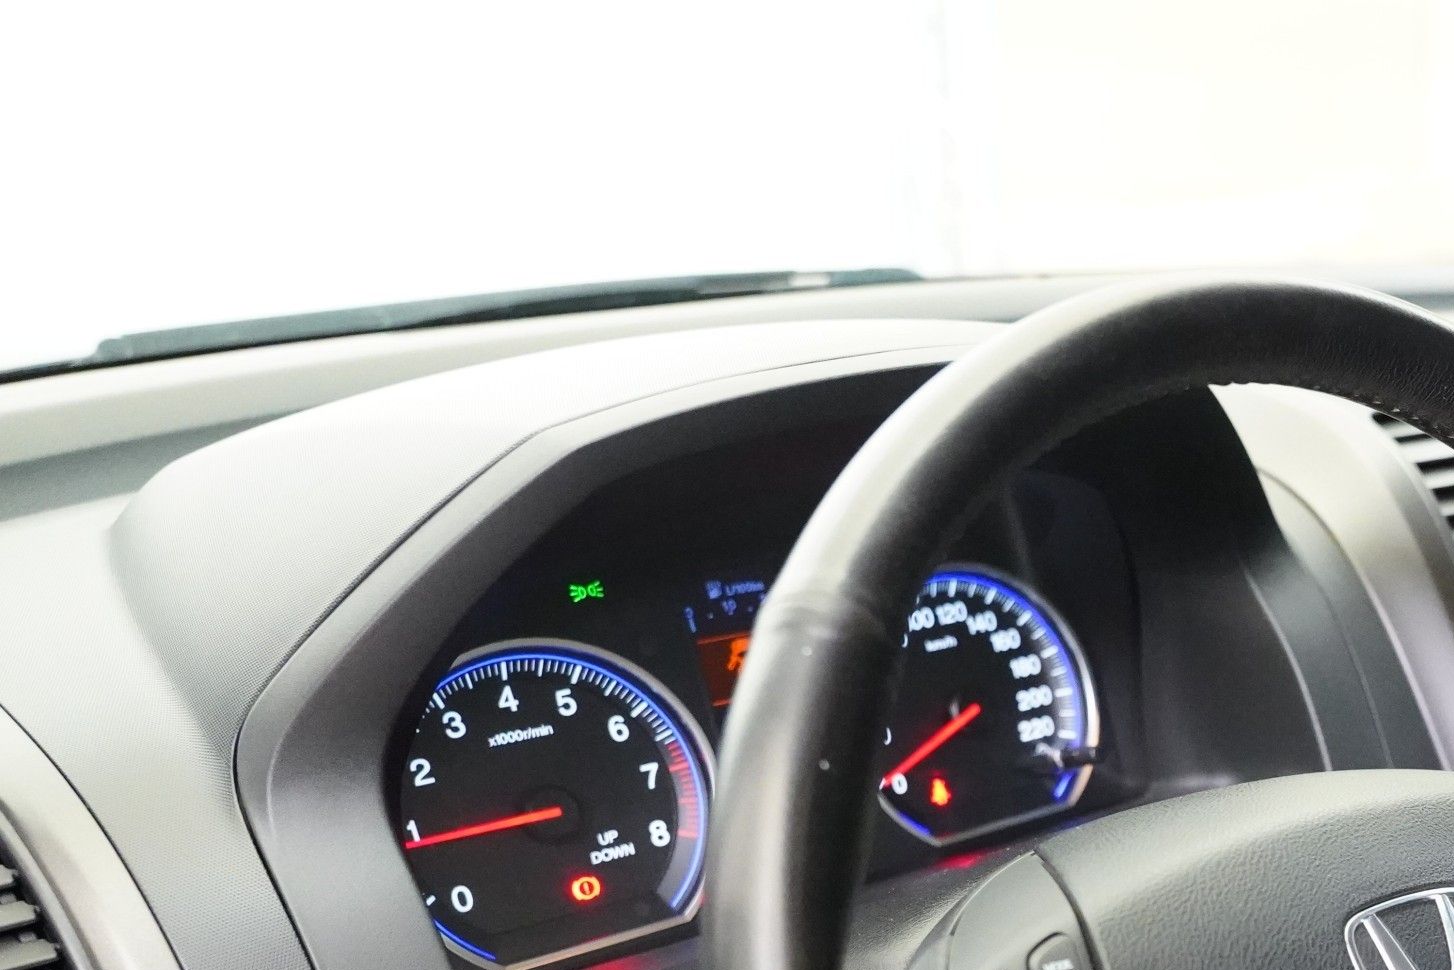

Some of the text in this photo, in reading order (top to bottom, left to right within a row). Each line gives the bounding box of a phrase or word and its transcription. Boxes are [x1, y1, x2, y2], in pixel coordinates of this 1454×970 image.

[935, 600, 968, 626] 120
[966, 610, 998, 635] 140
[498, 685, 519, 712] 4
[555, 688, 578, 717] 5
[442, 711, 467, 739] 3
[607, 715, 630, 743] 6
[409, 758, 436, 787] 2
[639, 761, 659, 790] 7
[892, 773, 908, 795] 0
[406, 819, 421, 842] 1
[596, 829, 619, 846] UP
[648, 819, 671, 847] 8
[589, 842, 636, 866] DOWN
[450, 885, 474, 913] 0
